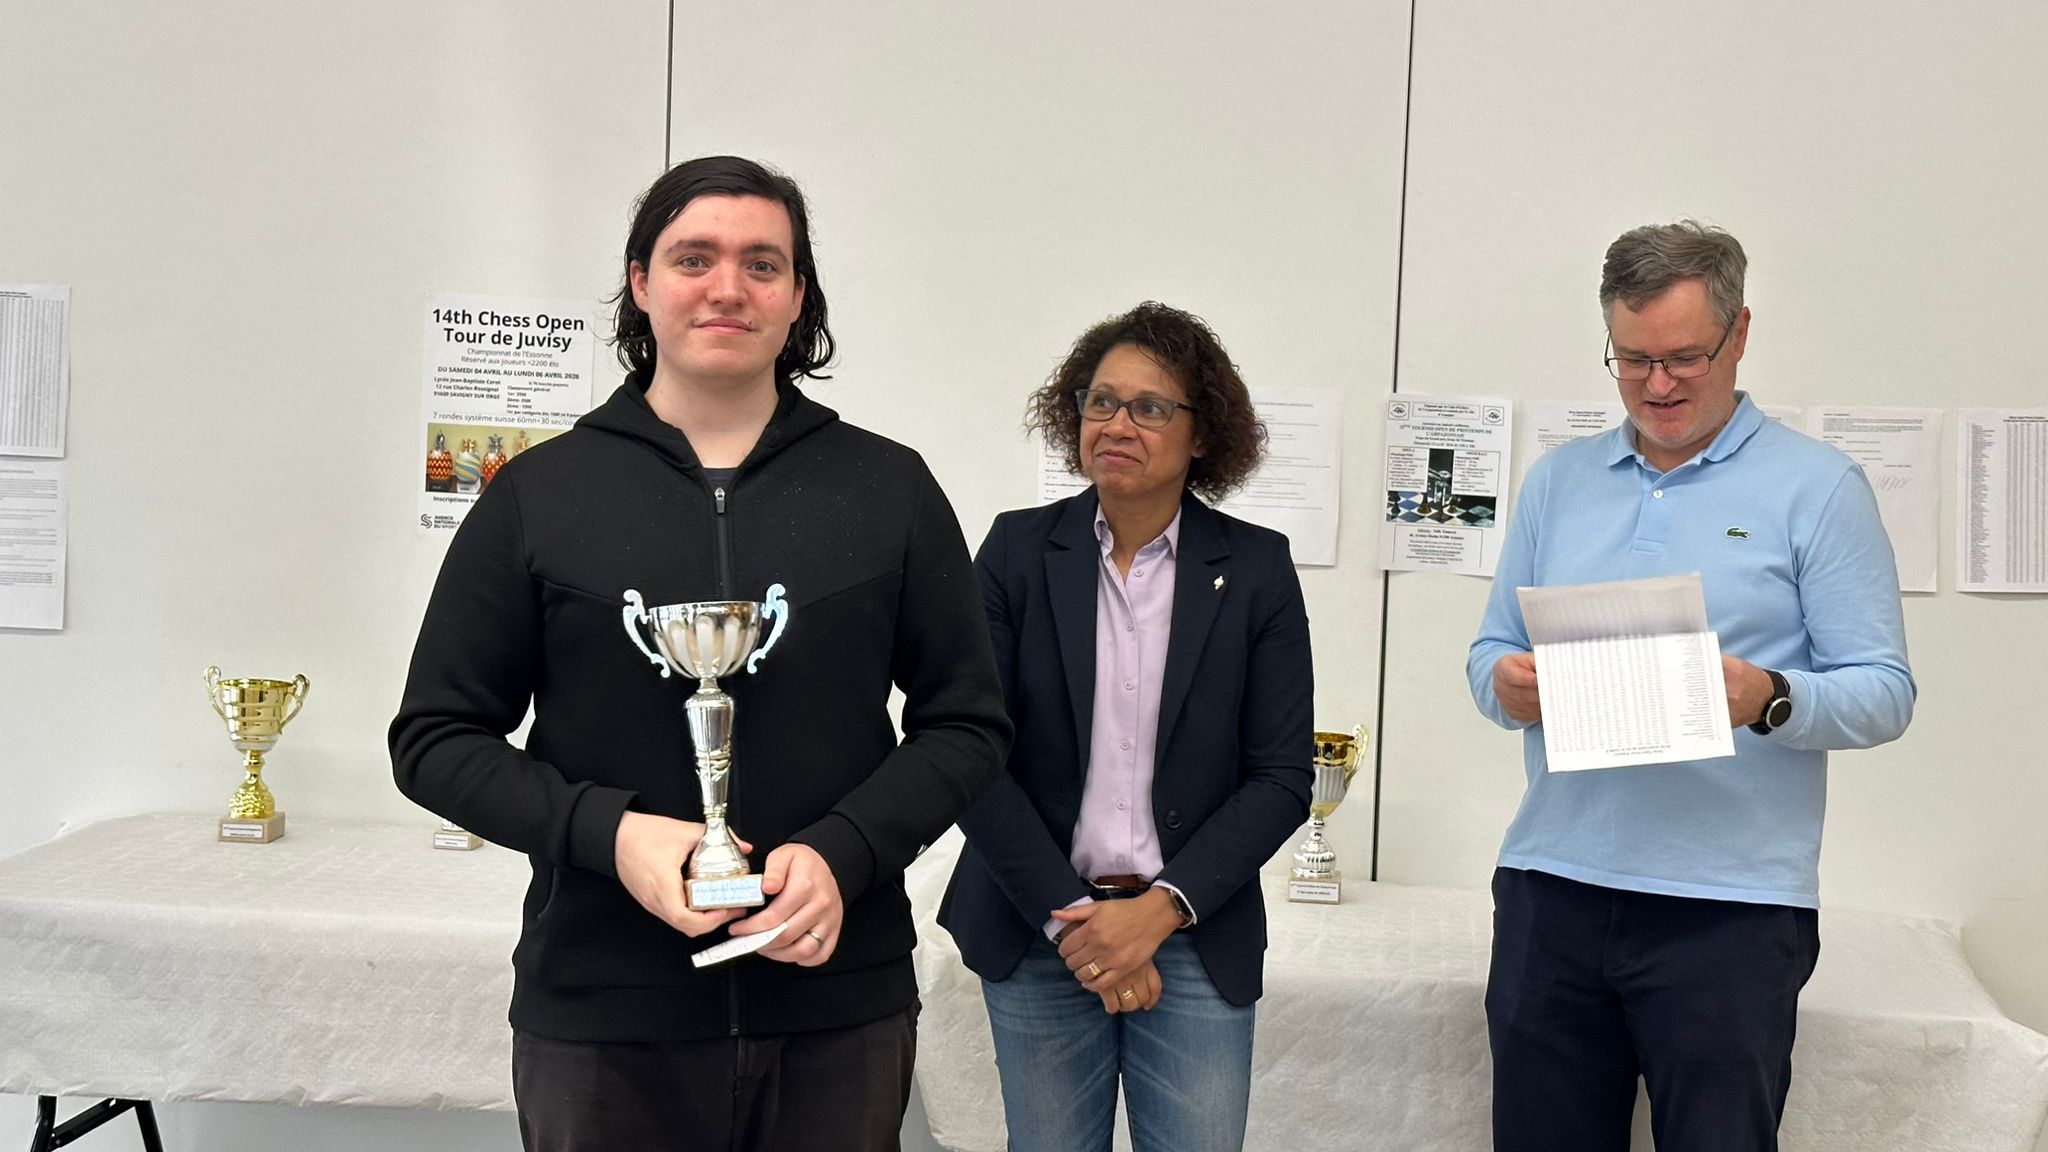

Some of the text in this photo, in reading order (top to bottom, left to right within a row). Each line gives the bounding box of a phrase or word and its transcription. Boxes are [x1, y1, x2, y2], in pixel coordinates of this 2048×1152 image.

[433, 309, 584, 333] 14th Chess Open
[444, 328, 572, 352] Tour de Juvisy
[467, 348, 511, 357] Championnat
[438, 412, 463, 420] rondes
[464, 413, 493, 422] système
[494, 415, 516, 423] suisse
[433, 496, 469, 504] Inscriptions
